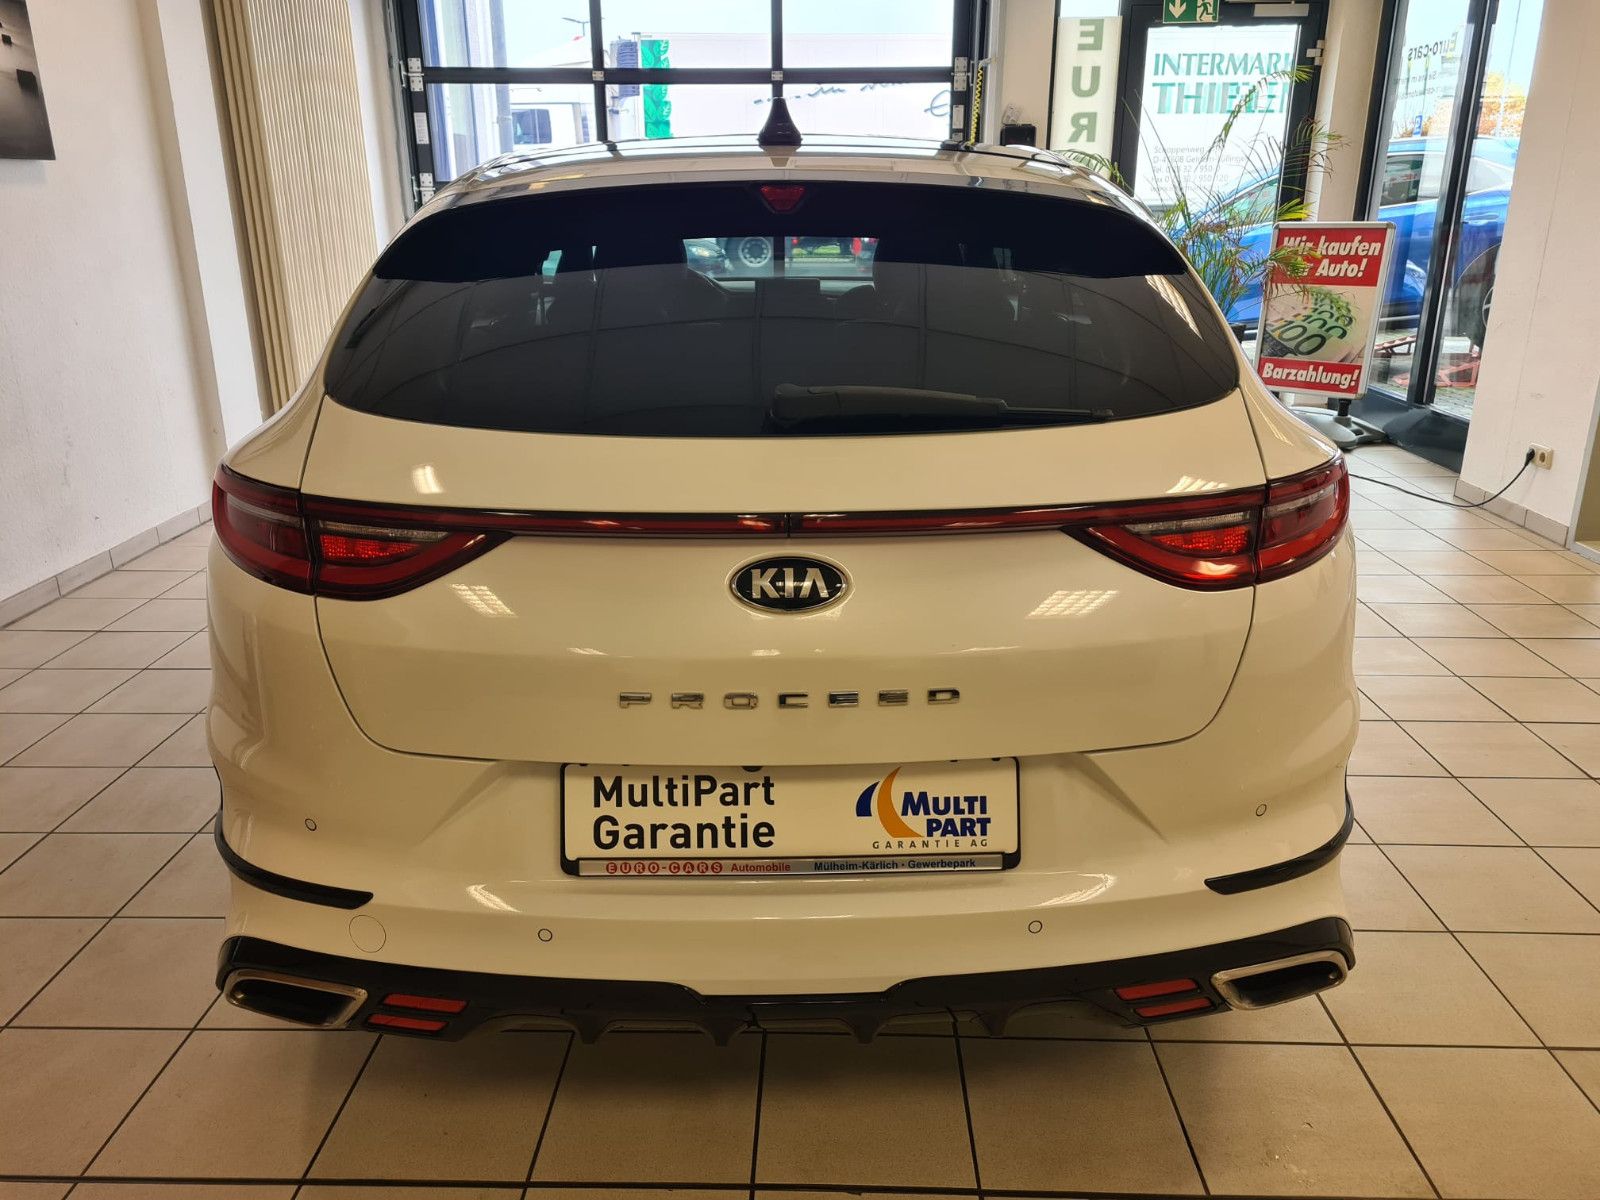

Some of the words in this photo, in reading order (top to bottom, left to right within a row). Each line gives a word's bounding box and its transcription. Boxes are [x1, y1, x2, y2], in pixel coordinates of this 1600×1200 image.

[1318, 235, 1381, 256] kaufen
[1315, 258, 1367, 277] Auto!
[1261, 362, 1360, 389] Barzahlung!
[750, 566, 830, 599] KIA
[619, 687, 961, 710] PROCEED
[593, 774, 775, 808] MultiPart
[901, 791, 987, 816] MULTI
[593, 812, 776, 850] Garantie
[926, 817, 992, 838] PART
[872, 839, 961, 850] GARANTIE
[970, 837, 988, 848] AG
[605, 861, 723, 875] EURO-CARS
[731, 862, 791, 873] Automobile
[814, 858, 899, 872] Mülheim-Kärlich
[907, 858, 976, 871] Gewerbepark
